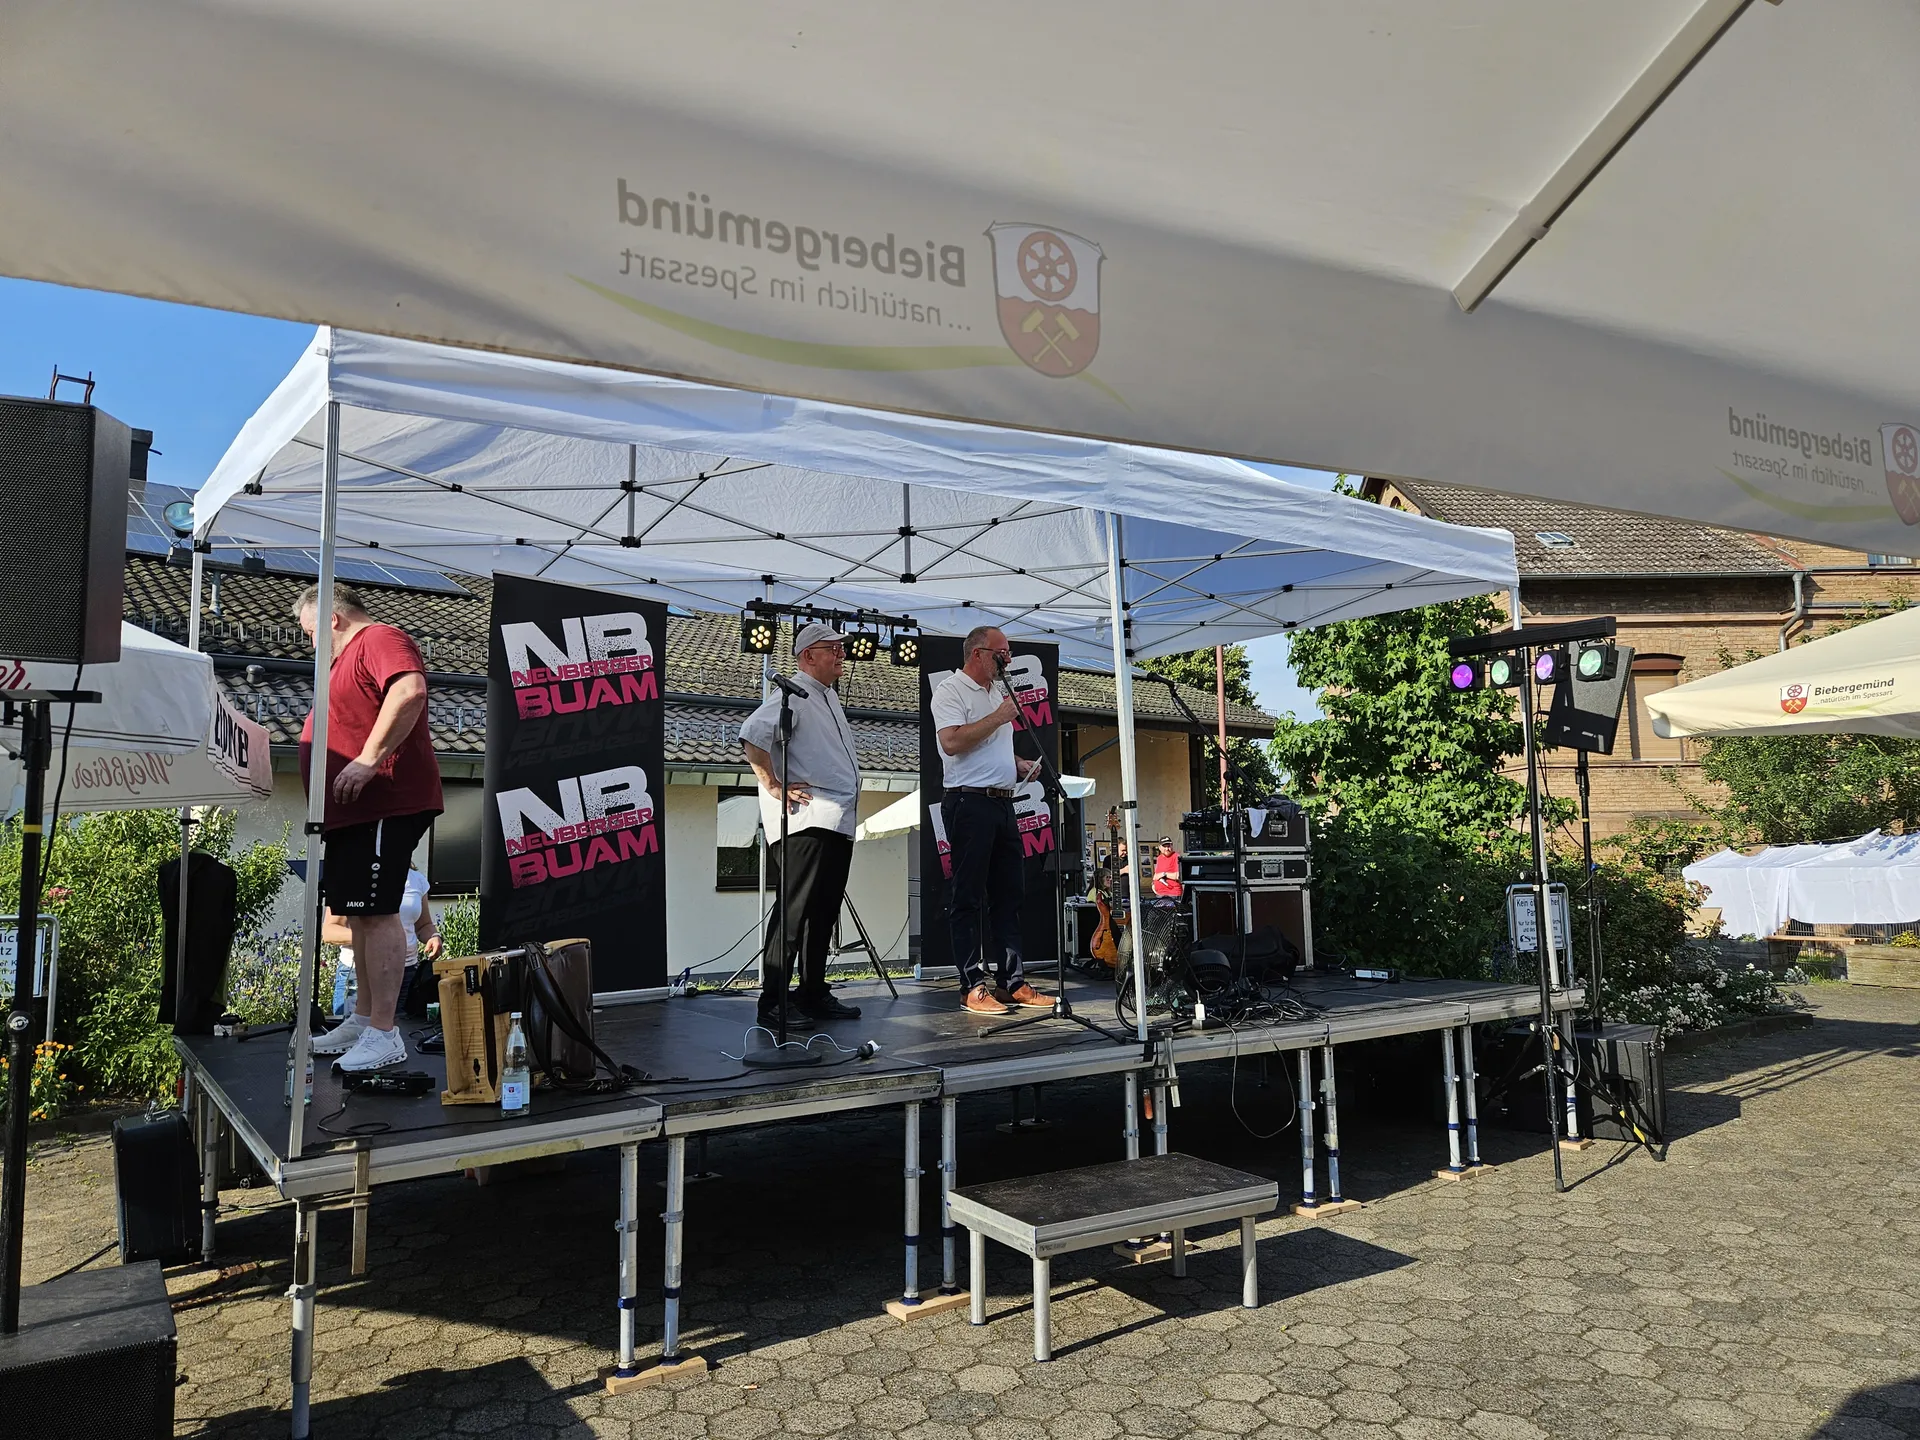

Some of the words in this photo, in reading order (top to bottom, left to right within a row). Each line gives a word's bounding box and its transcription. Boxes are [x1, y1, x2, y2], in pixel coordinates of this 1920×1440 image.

[501, 612, 654, 688] NB
[511, 655, 655, 687] NEUBERGER
[515, 671, 659, 720] BUAM
[1814, 678, 1895, 696] Biebergemünd
[1863, 690, 1893, 699] Spessart
[496, 765, 654, 857] NB
[506, 807, 655, 855] NEUBERGER
[508, 823, 659, 889] BUAM
